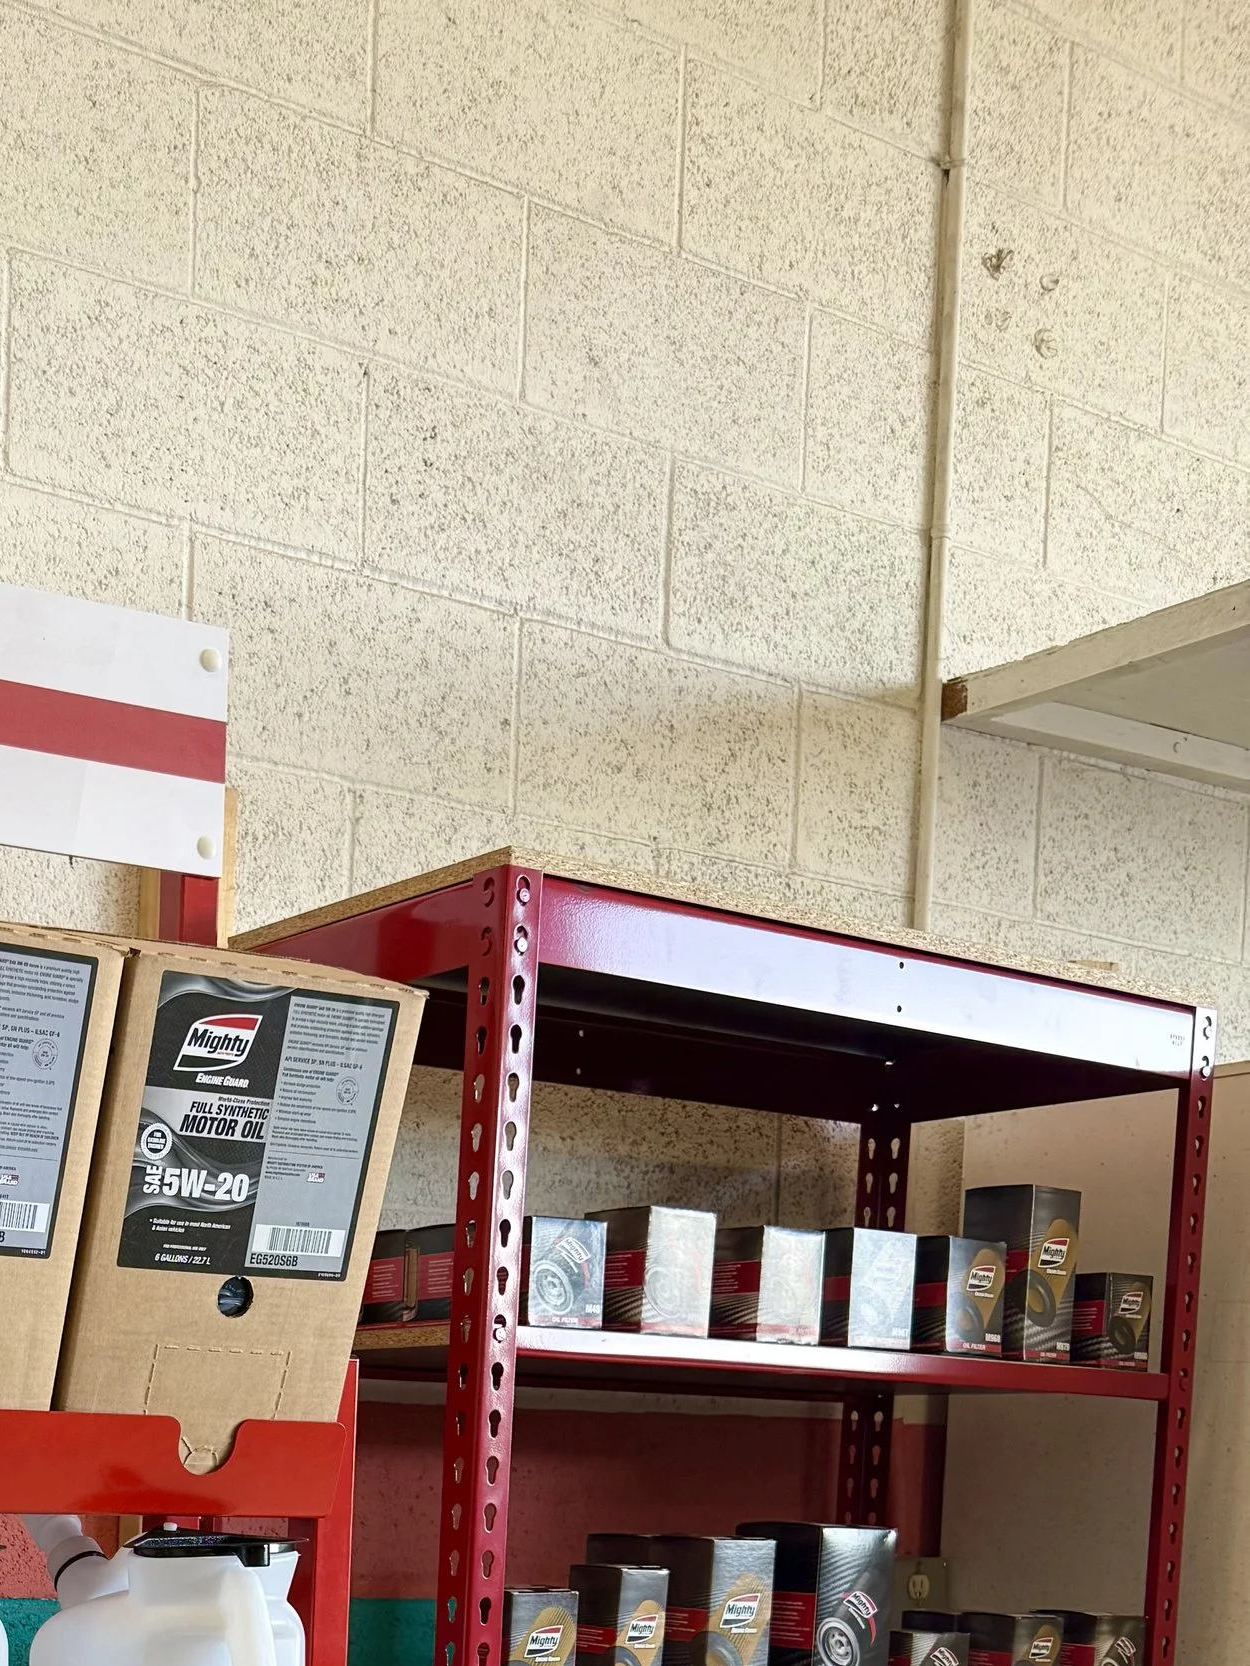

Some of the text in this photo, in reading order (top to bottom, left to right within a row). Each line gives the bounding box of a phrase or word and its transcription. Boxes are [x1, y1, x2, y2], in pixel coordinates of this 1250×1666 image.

[187, 1027, 249, 1057] Mighty
[196, 1073, 249, 1088] ENGINE GUARD
[190, 1101, 269, 1120] FULL SYNTHETIC
[179, 1115, 264, 1139] MOTOR OIL
[143, 1166, 161, 1193] SAE
[162, 1168, 249, 1202] 5W-20
[161, 1254, 188, 1263] GALLONS
[193, 1256, 207, 1264] 22.7
[250, 1253, 298, 1267] EG520S6B
[725, 1604, 755, 1616] Mighty
[530, 1635, 558, 1646] Mighty
